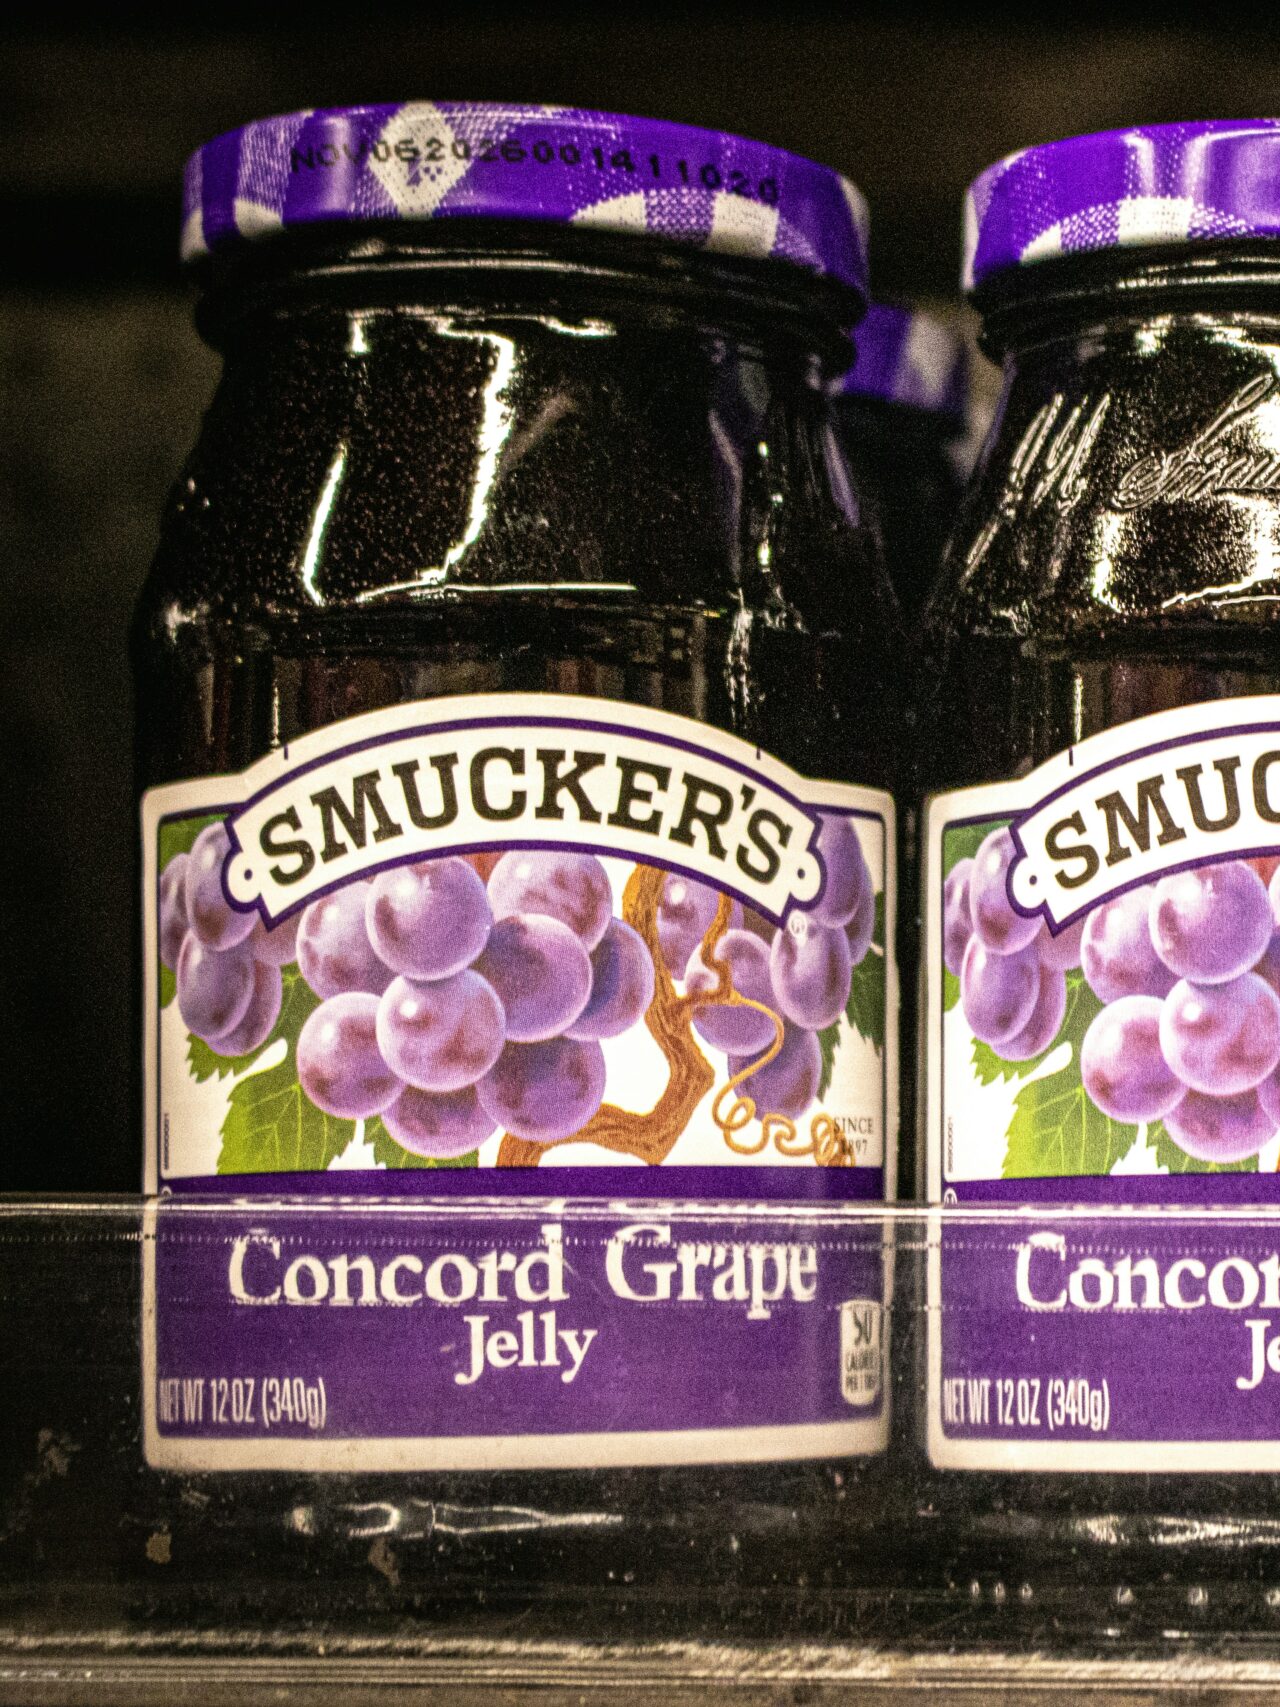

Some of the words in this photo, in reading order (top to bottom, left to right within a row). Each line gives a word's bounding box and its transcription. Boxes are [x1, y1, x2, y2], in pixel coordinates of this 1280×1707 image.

[258, 747, 794, 885] SMUCKER'S
[228, 1223, 571, 1305] Concord
[605, 1223, 818, 1321] Grape
[455, 1310, 598, 1384] Jelly
[182, 1376, 205, 1423] WT
[210, 1376, 228, 1423] 12
[232, 1376, 256, 1424] OZ
[261, 1376, 327, 1430] (340g)
[943, 1377, 966, 1424] NET
[968, 1377, 991, 1425] WT
[996, 1377, 1015, 1426] 12
[1017, 1378, 1041, 1426] OZ
[1047, 1377, 1111, 1432] (340g)
